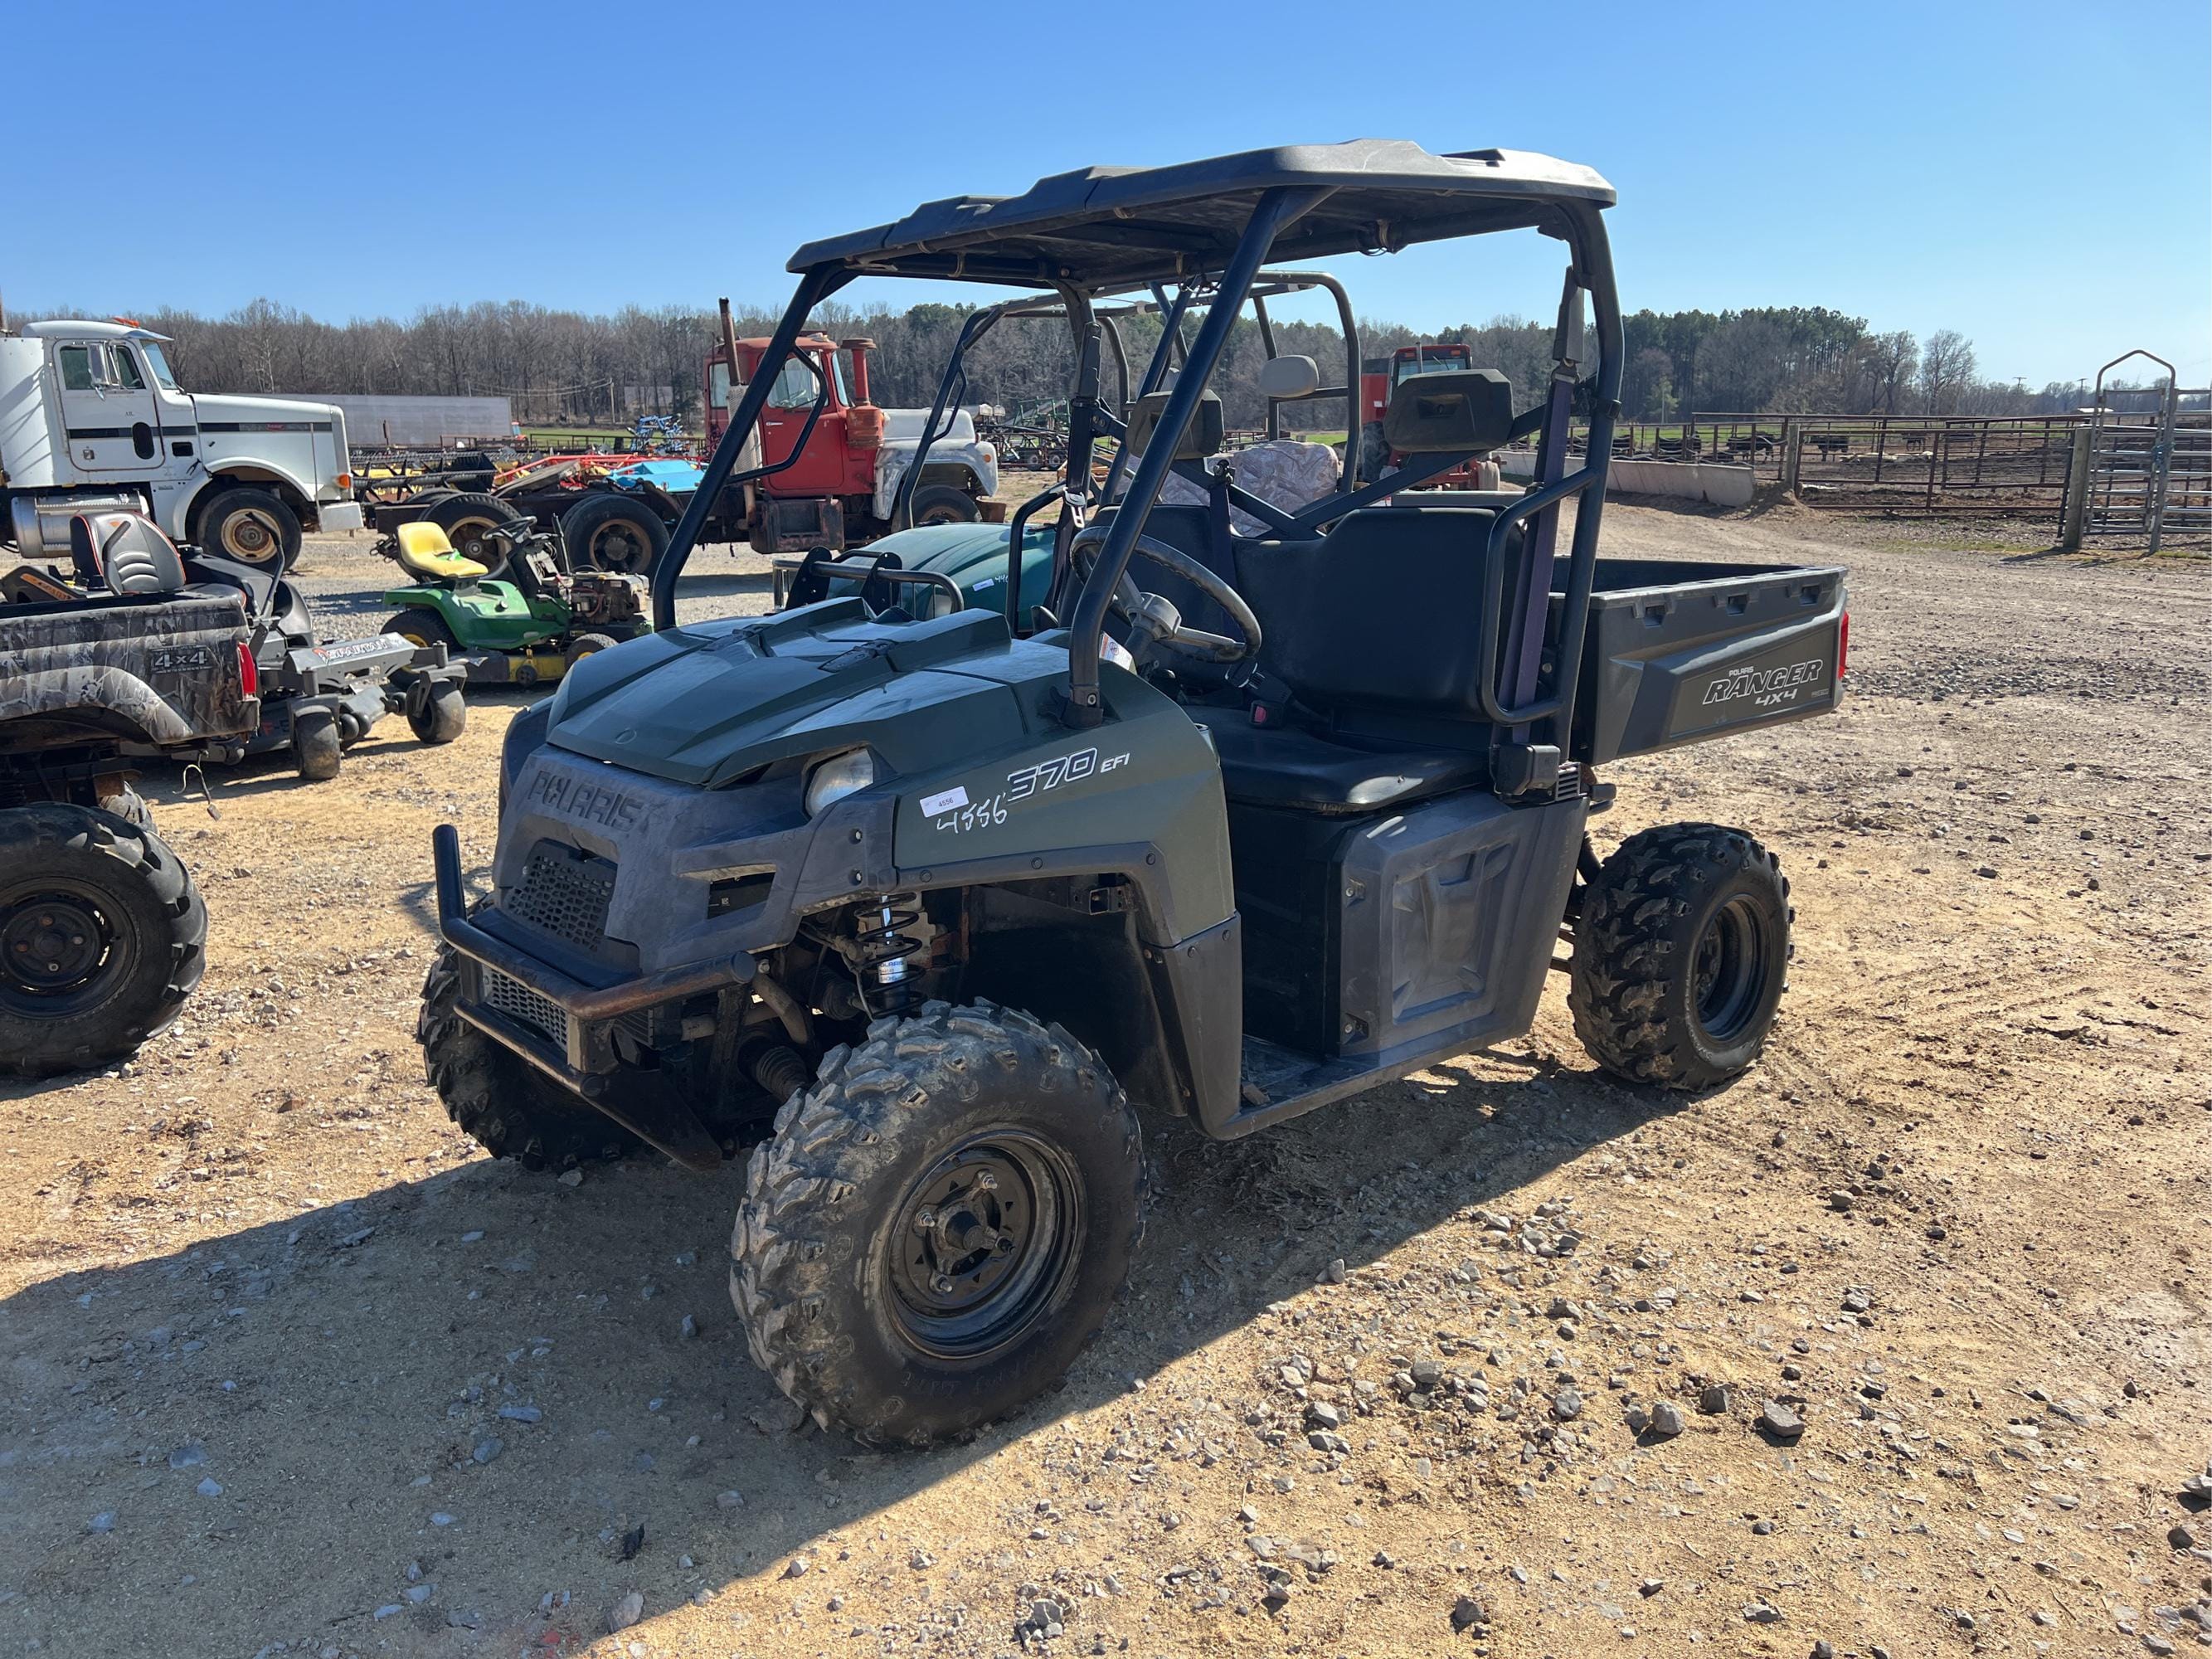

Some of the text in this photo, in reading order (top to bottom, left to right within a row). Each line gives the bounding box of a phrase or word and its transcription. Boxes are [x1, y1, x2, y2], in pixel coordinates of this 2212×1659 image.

[1702, 659, 1824, 705] RANGER
[1729, 666, 1754, 677] POLARIS
[1101, 752, 1130, 773] EFI
[527, 770, 644, 832] POLARIS
[936, 792, 1007, 834] 4556
[938, 797, 954, 807] 4556
